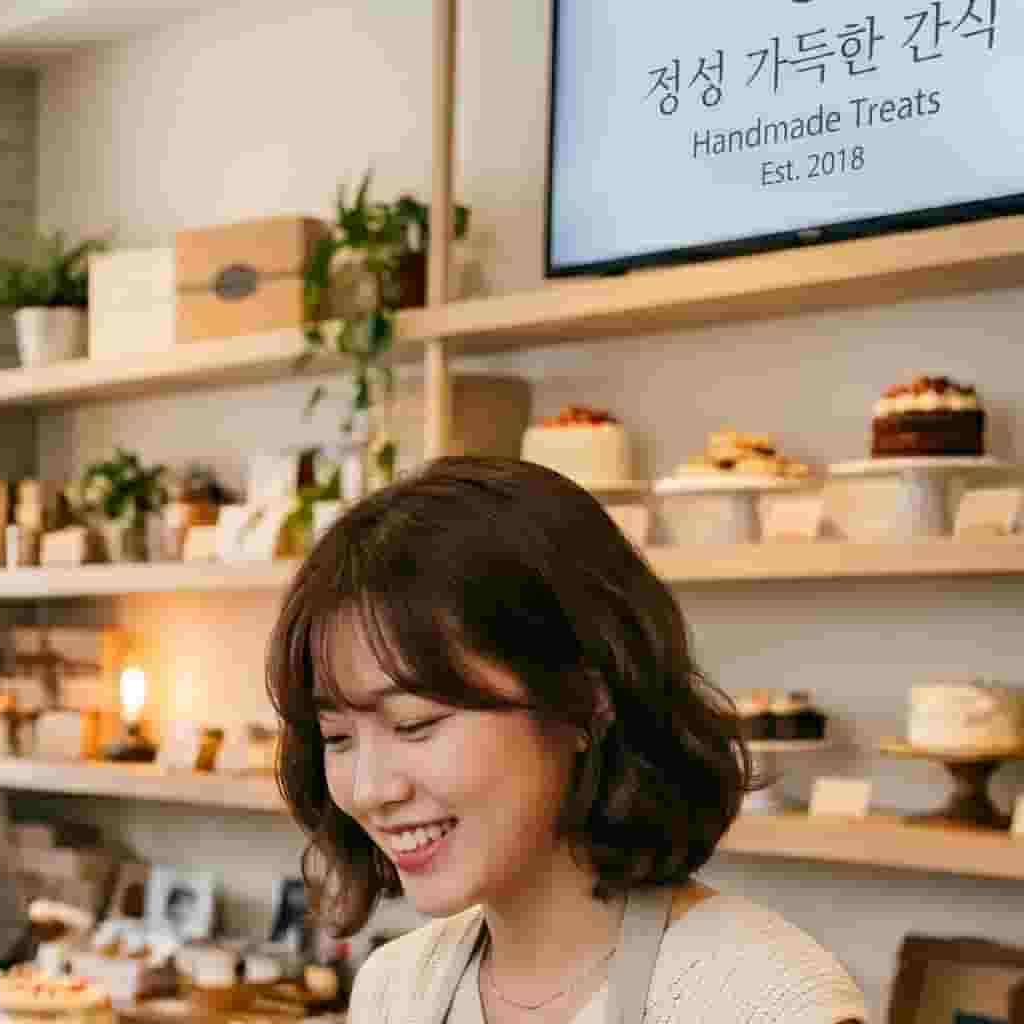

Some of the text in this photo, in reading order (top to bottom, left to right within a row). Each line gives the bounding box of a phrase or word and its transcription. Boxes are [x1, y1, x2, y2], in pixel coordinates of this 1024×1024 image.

[645, 0, 999, 116] 정성 가득한 간식
[692, 88, 941, 159] Handmade Treats
[760, 146, 866, 187] Est. 2018
